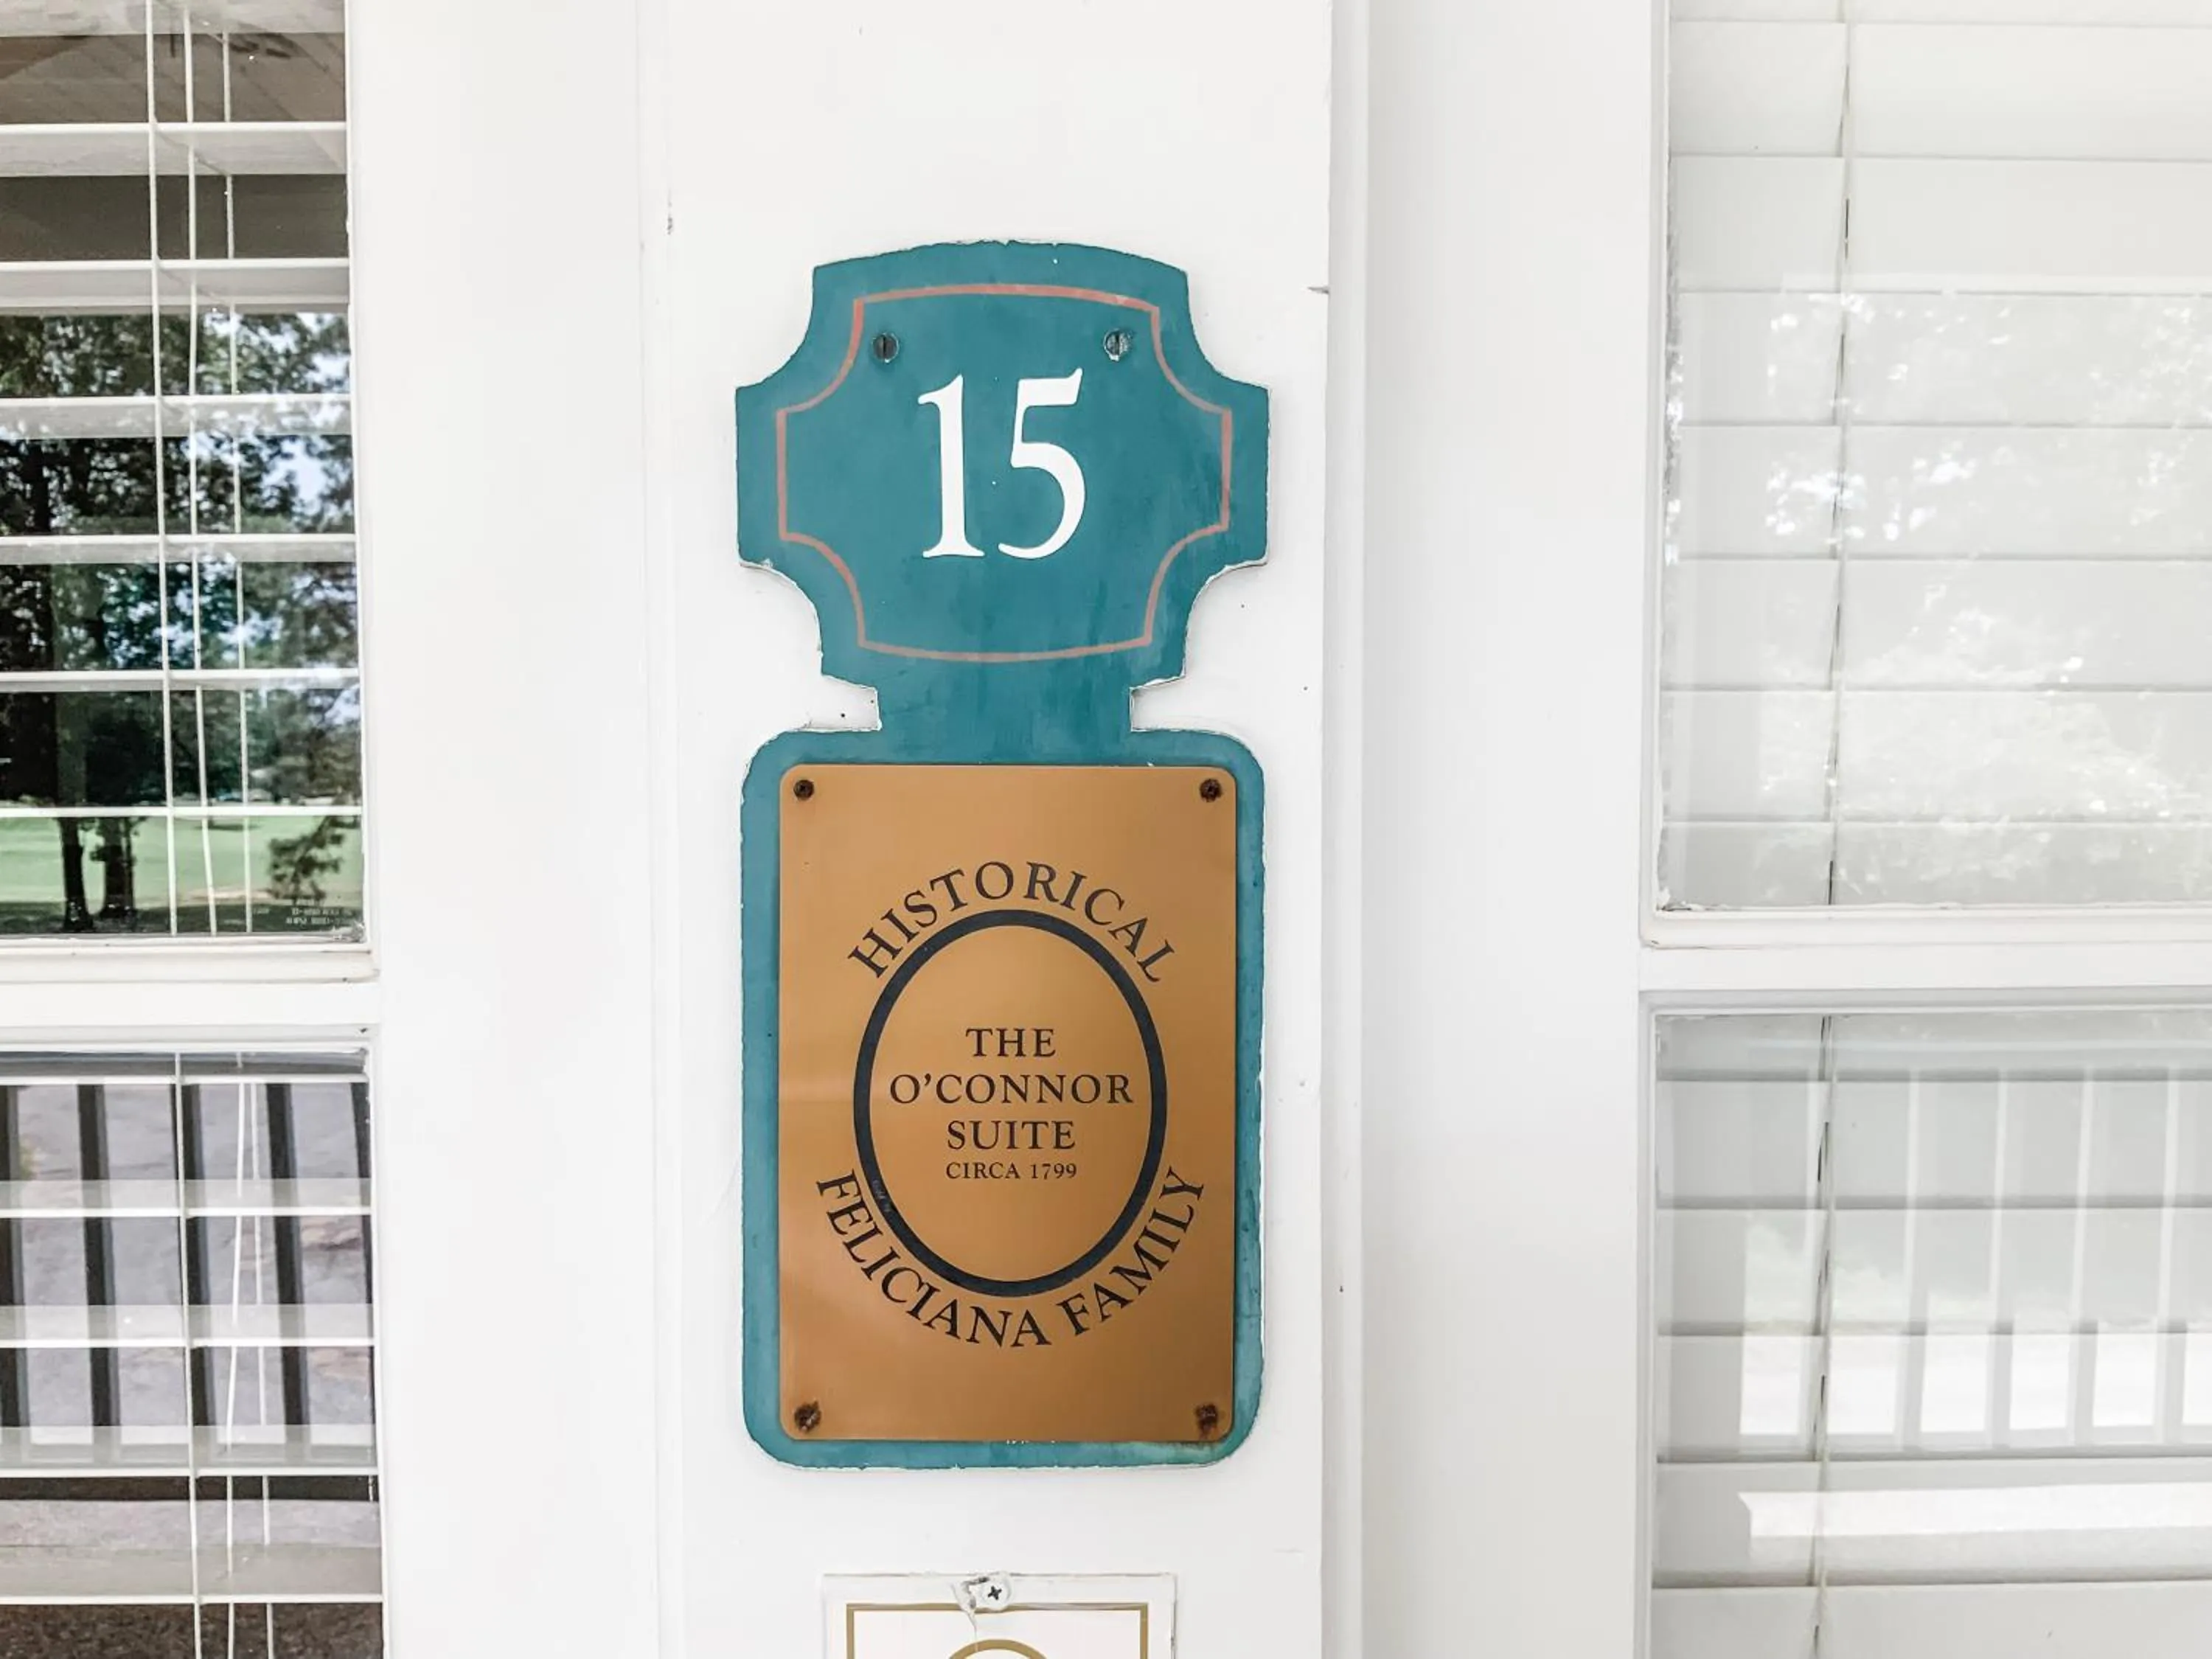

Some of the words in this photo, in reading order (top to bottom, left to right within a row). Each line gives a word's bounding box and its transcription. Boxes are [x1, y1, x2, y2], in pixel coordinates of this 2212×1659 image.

[917, 367, 1086, 560] 15
[848, 860, 1175, 983] HISTORICAL
[966, 1028, 1057, 1057] THE
[889, 1073, 1133, 1105] O'CONNOR
[947, 1120, 1076, 1150] SUITE
[946, 1162, 1021, 1180] CIRCA
[1030, 1161, 1077, 1180] 1799
[815, 1169, 1052, 1349] FELICIANA
[1056, 1166, 1205, 1335] FAMILY
